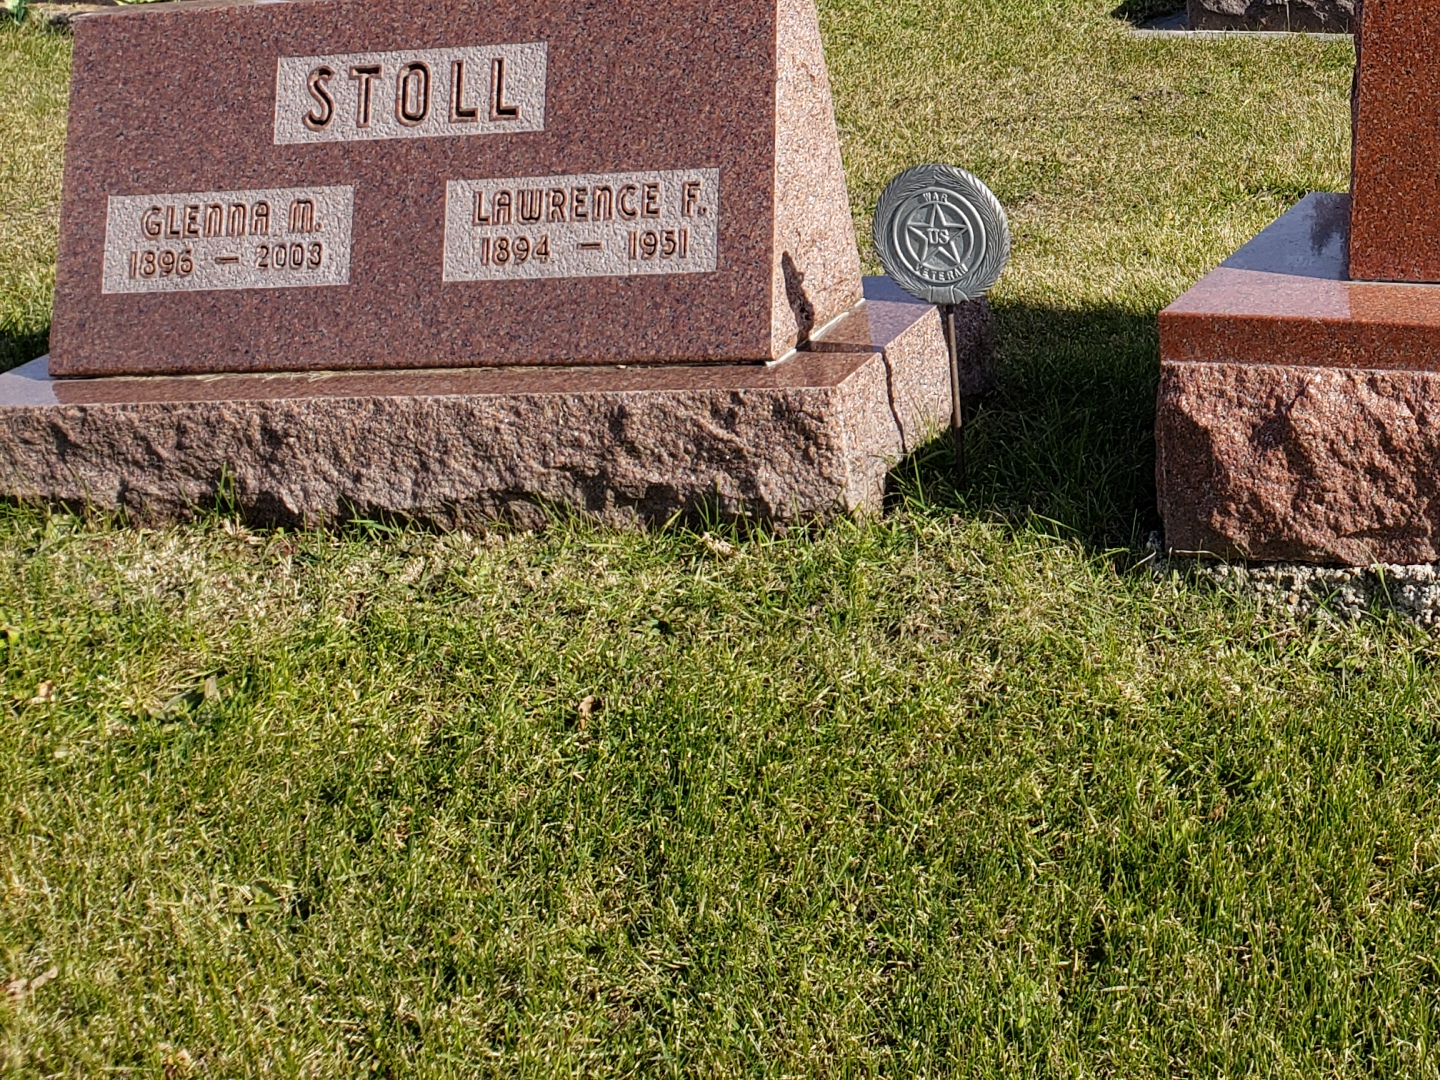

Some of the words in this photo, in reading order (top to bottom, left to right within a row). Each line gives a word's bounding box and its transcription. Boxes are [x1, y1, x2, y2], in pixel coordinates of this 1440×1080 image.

[300, 54, 522, 132] STOLL
[471, 181, 661, 227] LAWRENCE
[682, 180, 710, 218] F.
[923, 191, 948, 203] WAR
[141, 199, 270, 240] GLENNA
[288, 198, 324, 234] M.
[927, 228, 950, 245] US
[129, 248, 194, 281] 1896
[254, 241, 324, 270] 2003
[480, 234, 551, 267] 1894
[627, 227, 689, 261] 1951
[916, 262, 969, 281] VETERAN
